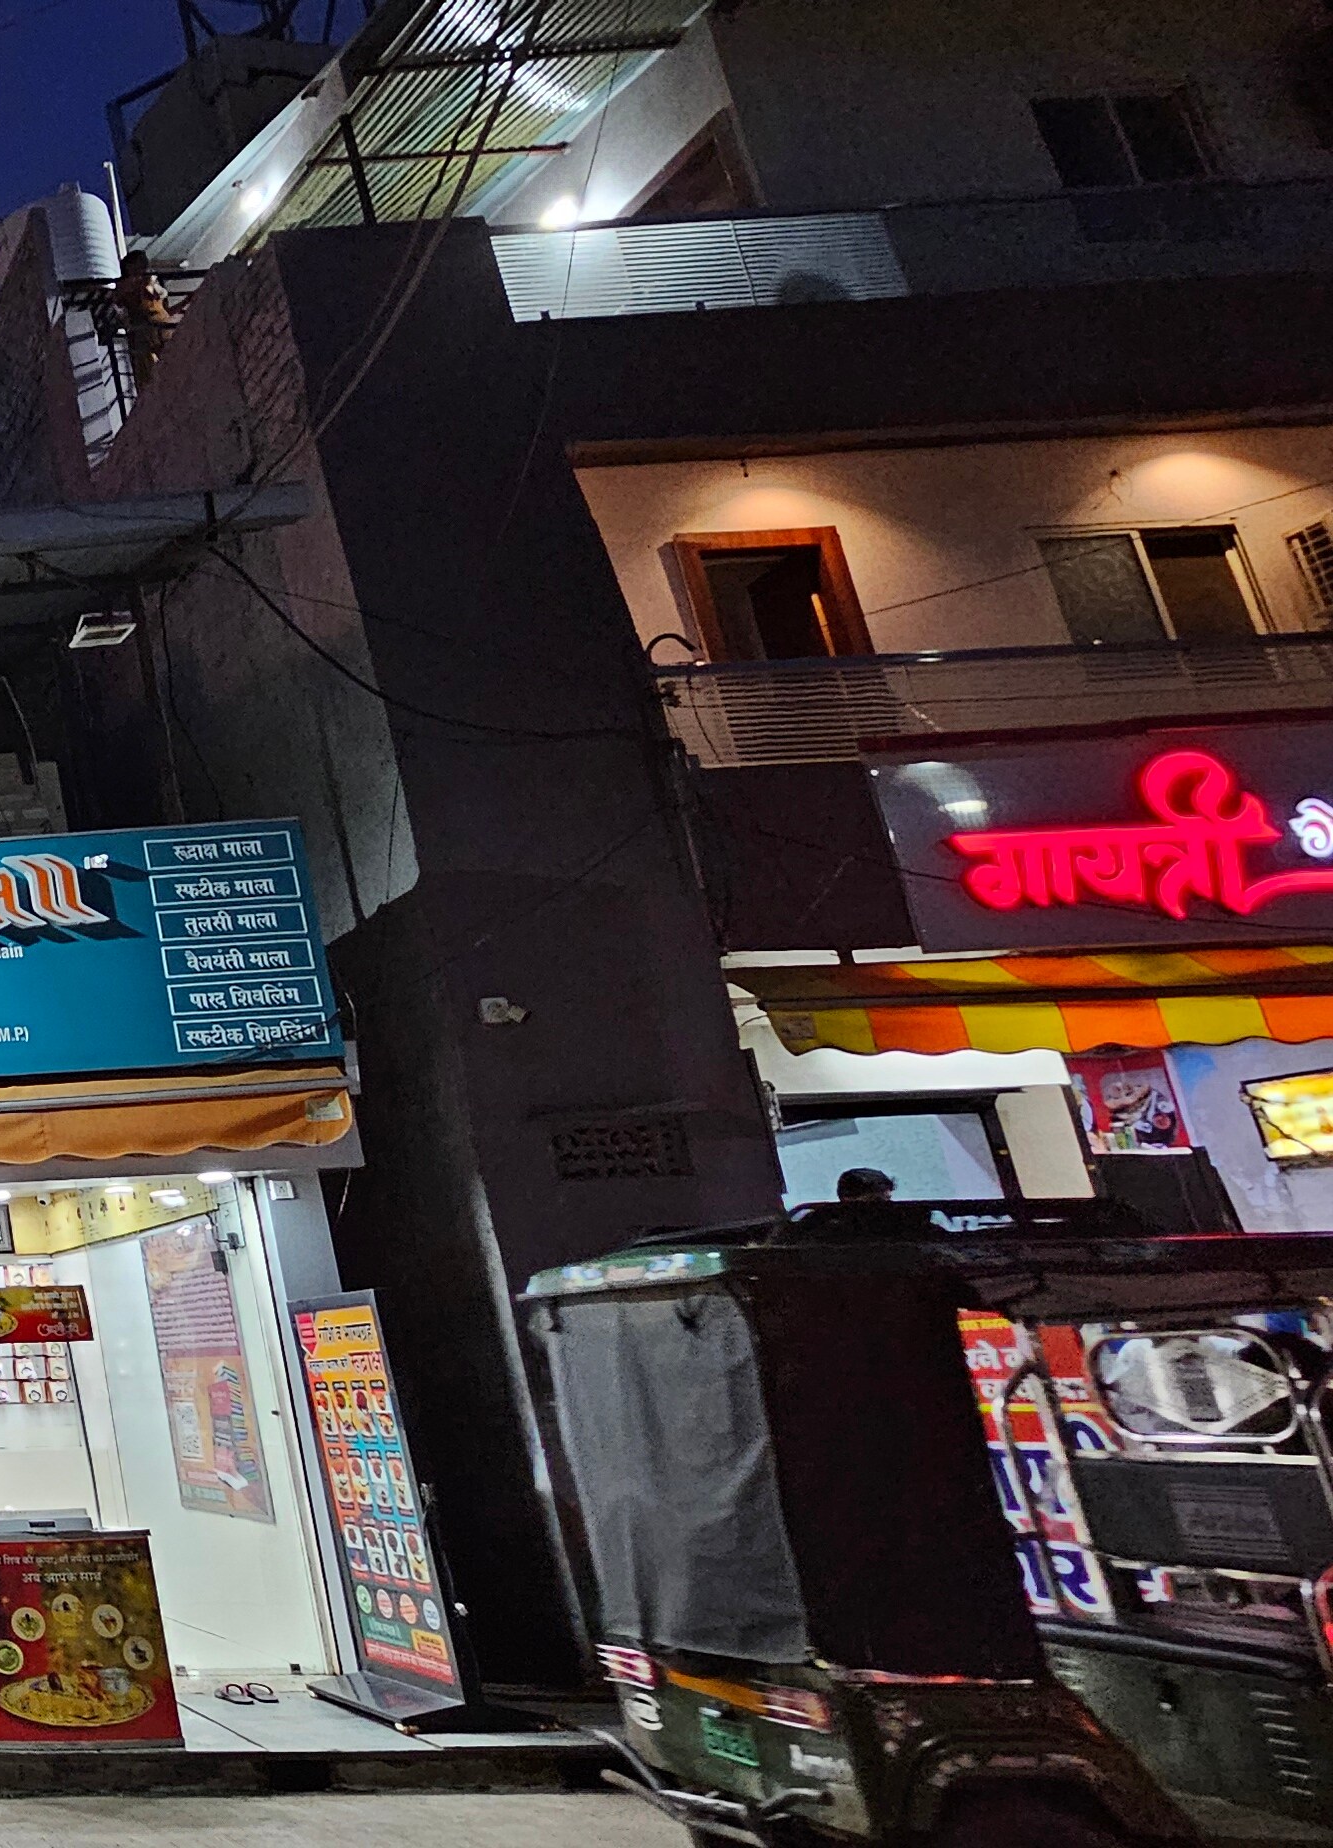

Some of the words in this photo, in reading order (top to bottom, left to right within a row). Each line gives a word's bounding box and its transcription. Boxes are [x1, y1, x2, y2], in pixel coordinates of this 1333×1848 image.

[947, 748, 1283, 921] गायत्री
[223, 840, 263, 857] माला
[234, 878, 276, 896] माला
[184, 910, 234, 937] तुलसी
[237, 912, 278, 929] माला
[248, 950, 292, 967] माला
[229, 982, 301, 1005] शिवलिंग
